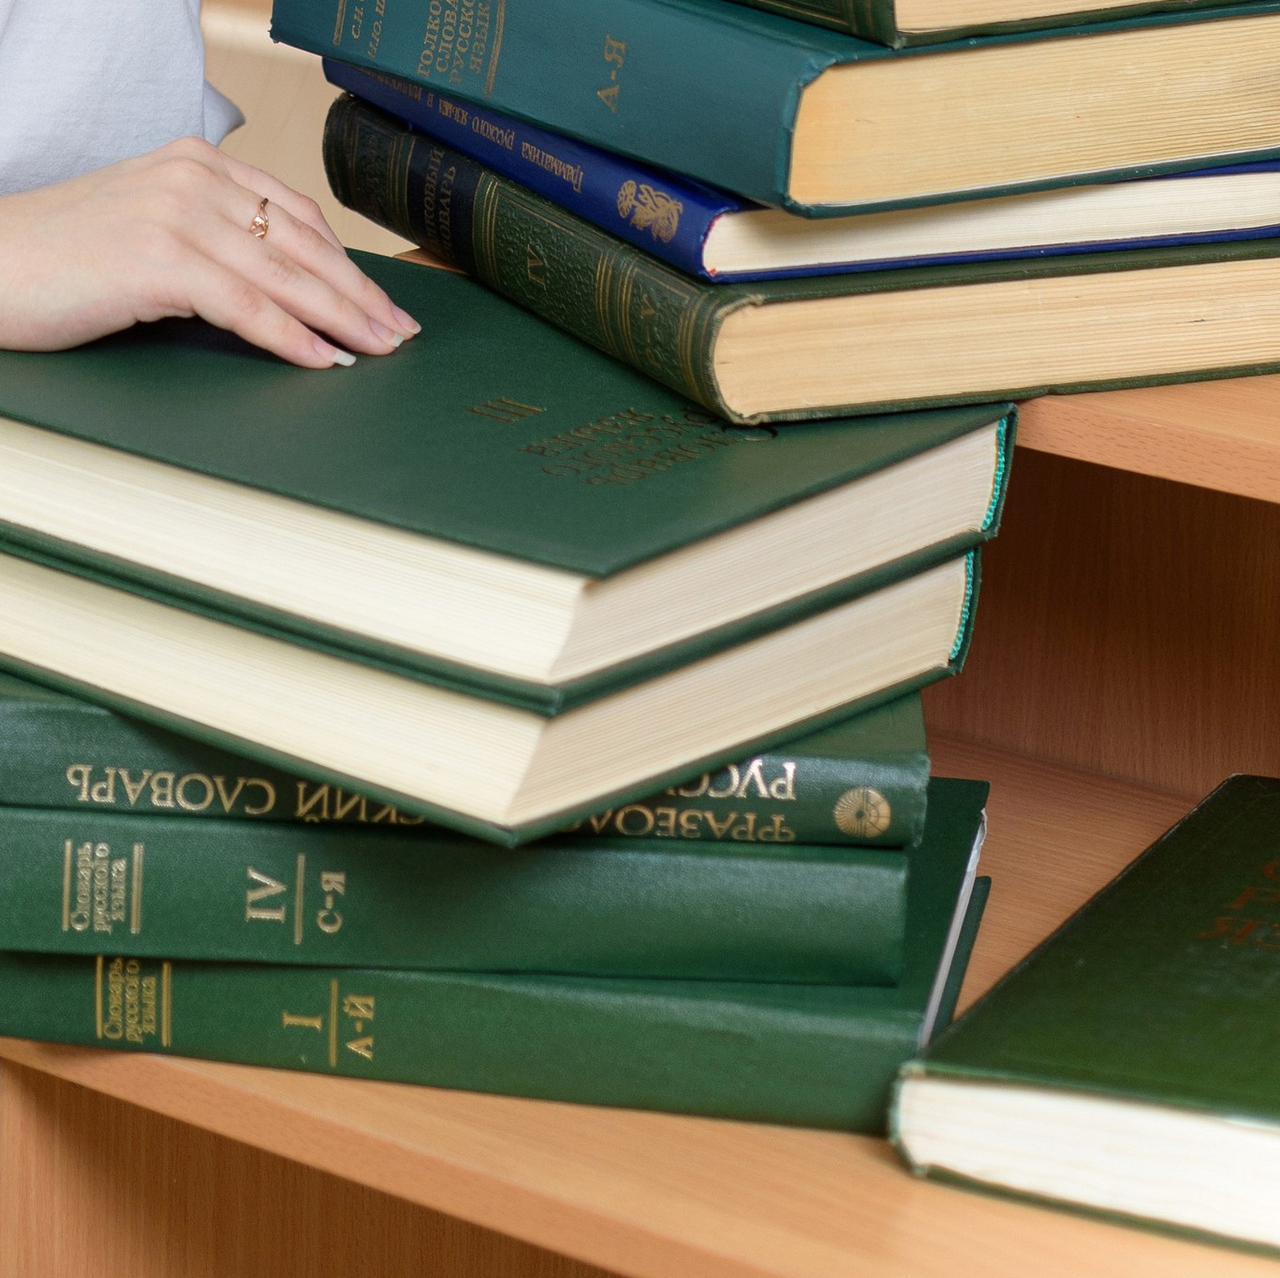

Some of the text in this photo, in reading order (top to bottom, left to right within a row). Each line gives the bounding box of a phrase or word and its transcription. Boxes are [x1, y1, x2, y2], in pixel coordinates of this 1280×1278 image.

[597, 34, 626, 114] А-Я
[438, 98, 469, 126] языка
[472, 116, 515, 150] русского
[521, 141, 584, 193] Грамматика
[66, 763, 276, 815] СЛОВАРЬ
[70, 841, 93, 931] Словарь
[93, 842, 112, 934] русского
[111, 858, 127, 922] языка
[246, 865, 287, 924] IV
[317, 871, 346, 933] С-Я
[104, 957, 125, 1040] Словарь
[125, 958, 144, 1045] русского
